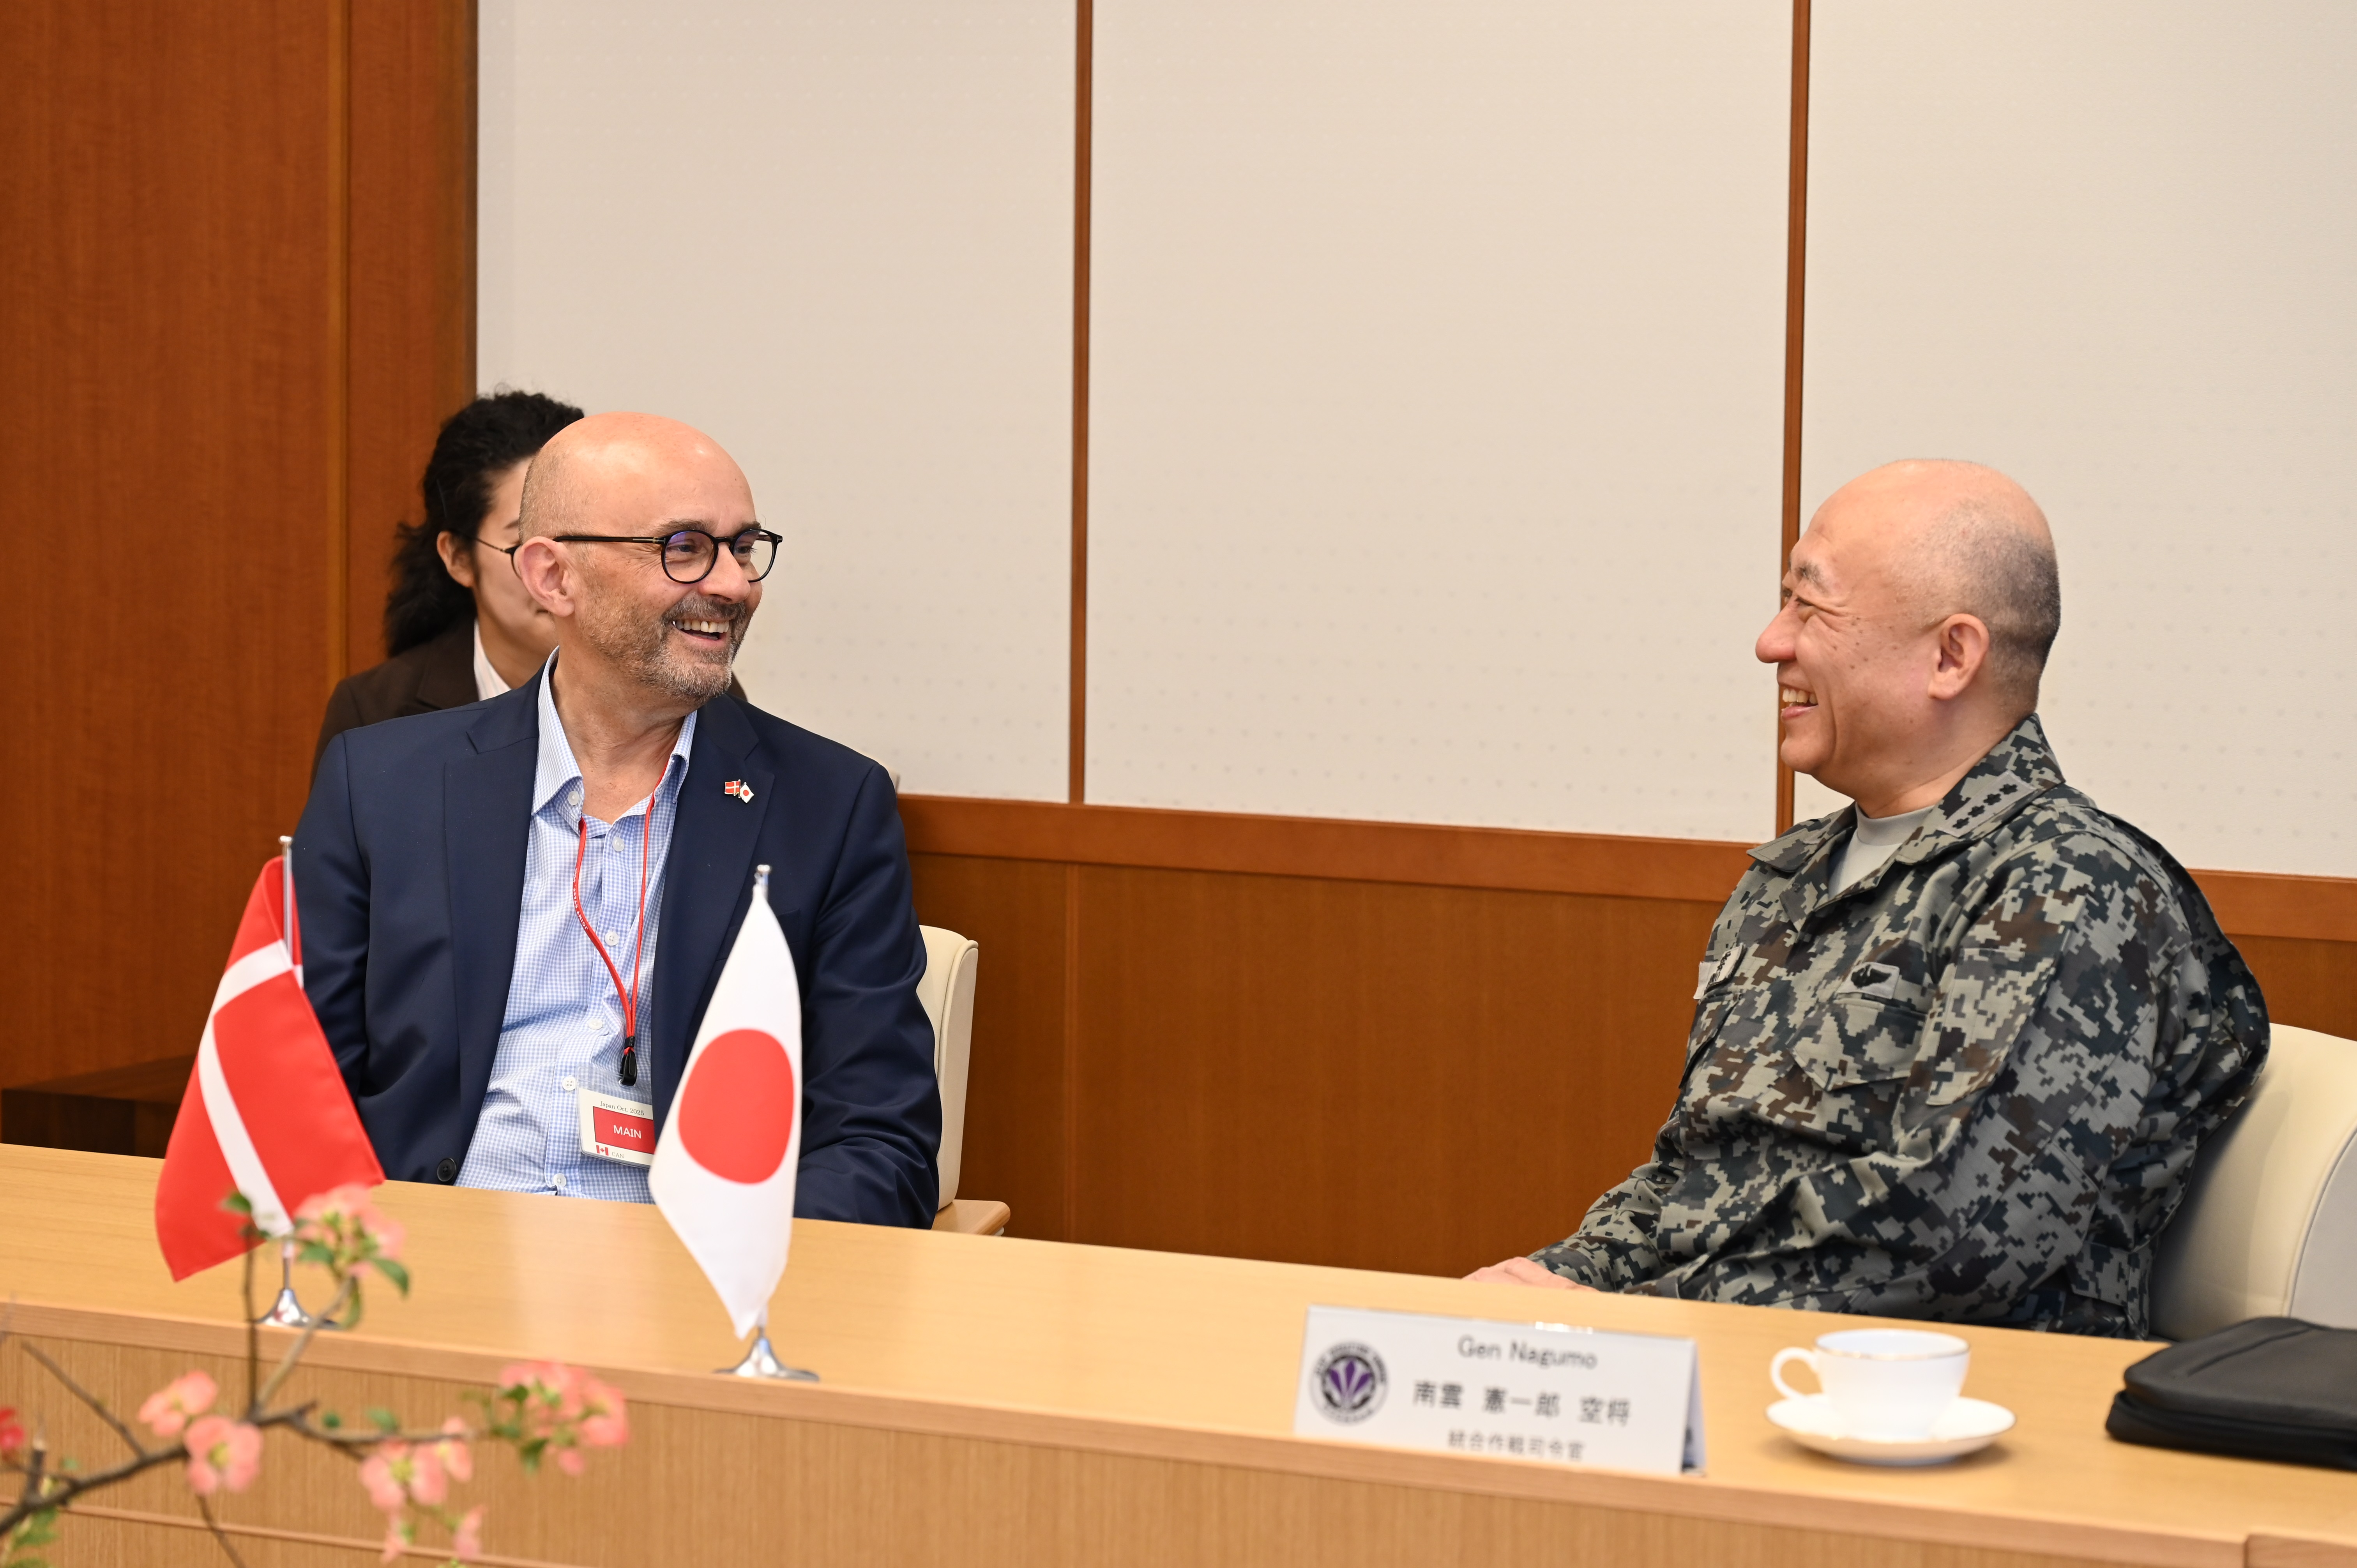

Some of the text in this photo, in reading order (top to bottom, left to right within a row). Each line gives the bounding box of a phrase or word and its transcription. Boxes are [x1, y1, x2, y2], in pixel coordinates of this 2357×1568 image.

[600, 1101, 615, 1109] Japan
[613, 1125, 641, 1139] MAIN
[1458, 1335, 1598, 1369] Gen Nagumo
